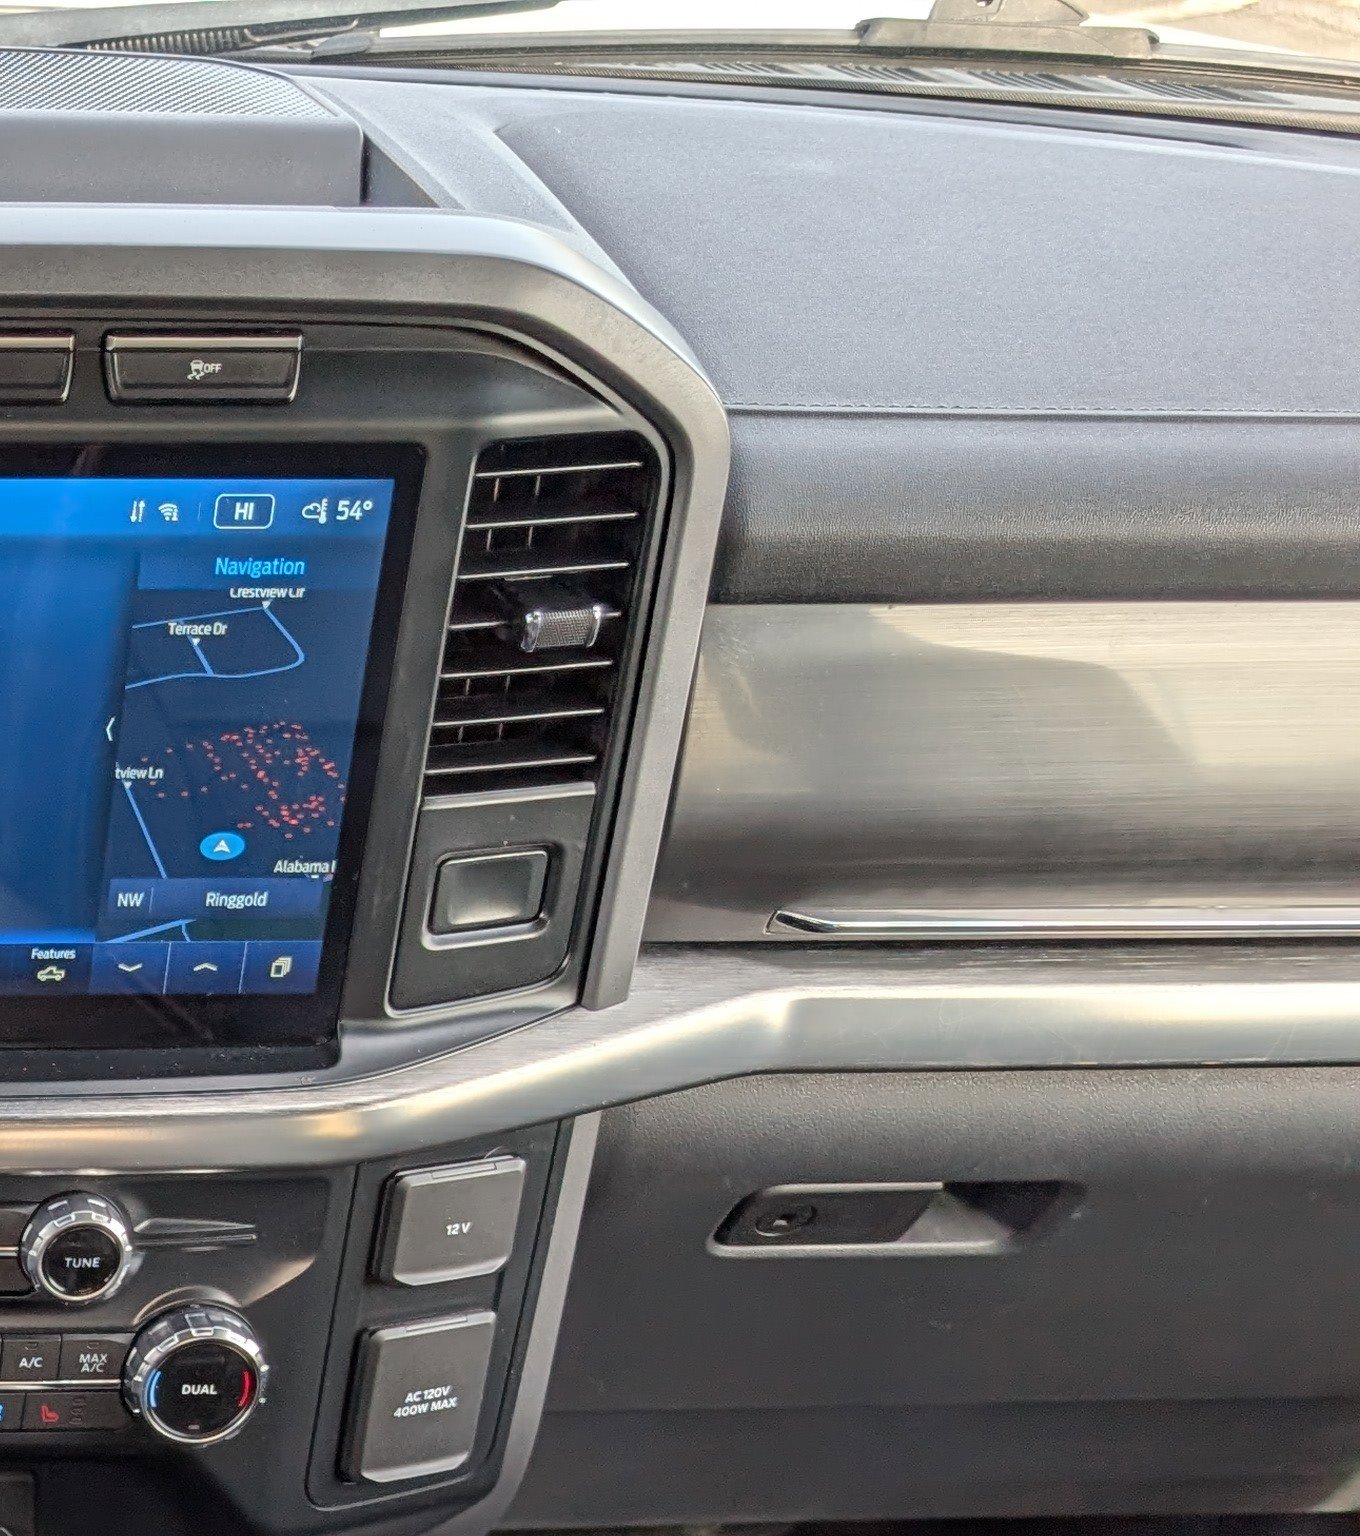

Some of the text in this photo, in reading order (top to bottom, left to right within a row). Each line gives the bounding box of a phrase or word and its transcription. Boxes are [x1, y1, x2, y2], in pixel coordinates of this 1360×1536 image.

[203, 362, 223, 374] OFF
[233, 501, 254, 522] HI
[214, 557, 305, 579] Navigation
[167, 621, 228, 636] Terrace Dr
[148, 766, 164, 779] Ln
[273, 859, 330, 873] Alabama
[117, 893, 144, 908] NW
[205, 891, 268, 910] Ringgold
[31, 948, 76, 961] Features
[65, 1257, 101, 1269] TUNE
[19, 1356, 44, 1369] A/C
[79, 1353, 108, 1364] MAX
[81, 1362, 105, 1373] A/C
[181, 1384, 218, 1395] DUAL
[405, 1385, 452, 1403] AC 120V
[394, 1397, 458, 1418] 400W MAX
